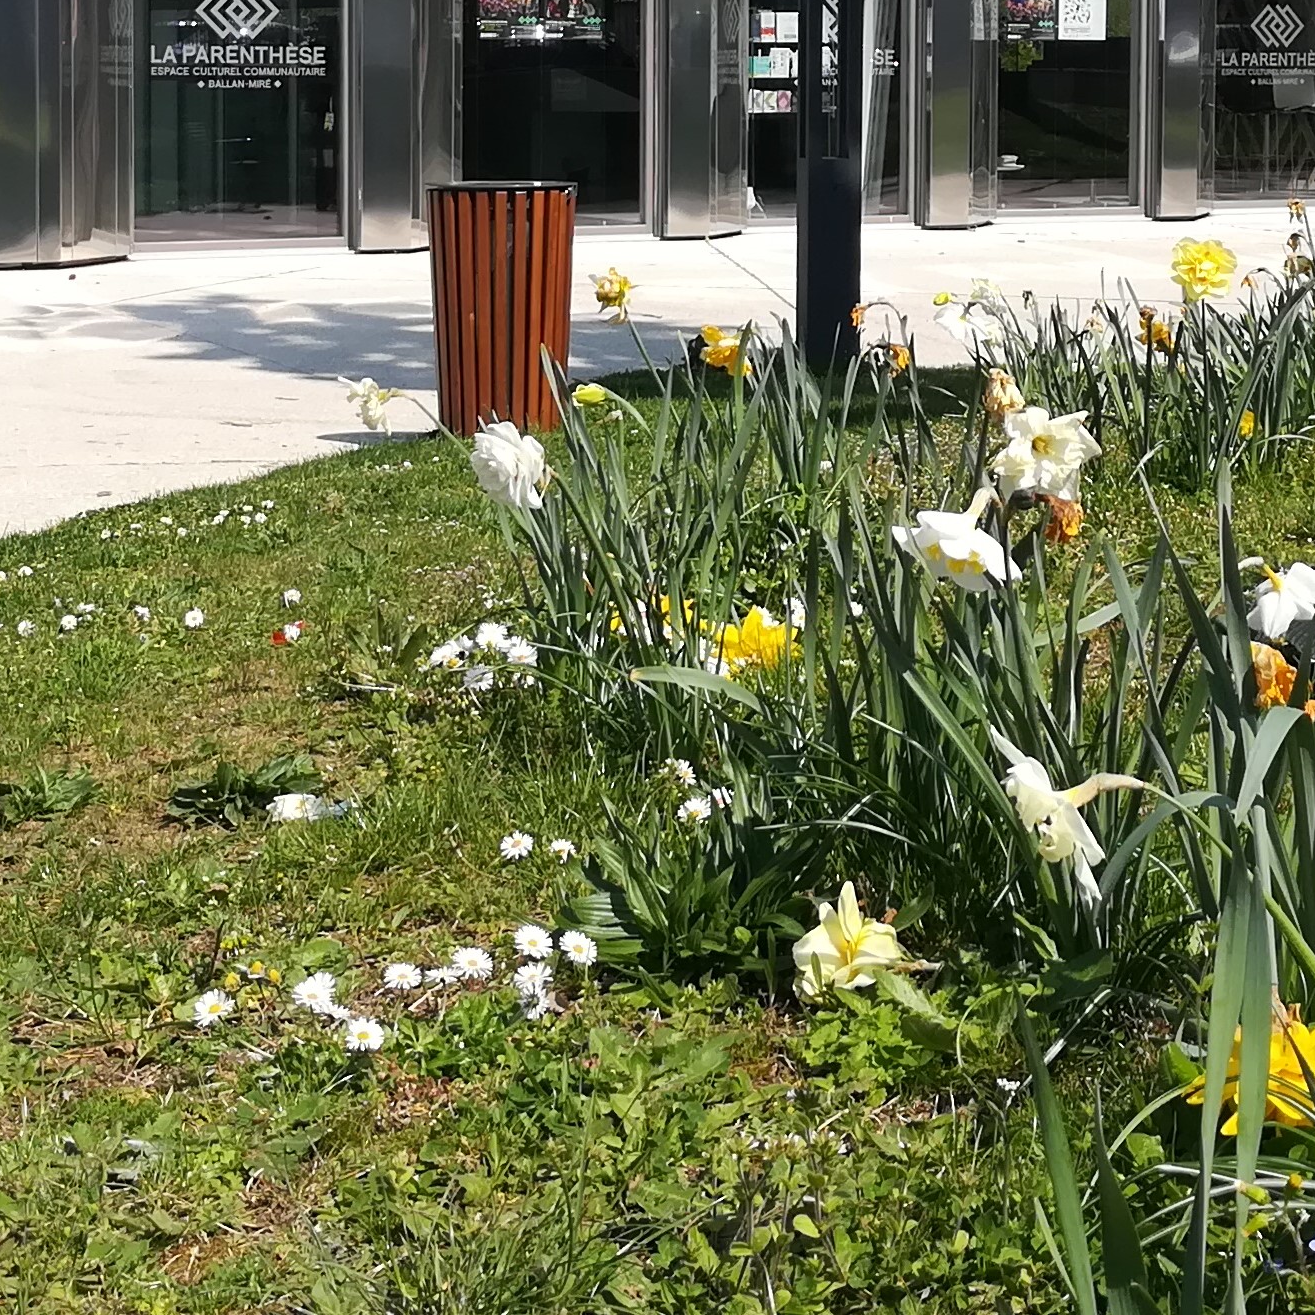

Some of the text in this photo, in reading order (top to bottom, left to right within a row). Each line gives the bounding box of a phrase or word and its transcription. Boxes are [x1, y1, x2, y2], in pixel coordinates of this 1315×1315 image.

[150, 45, 177, 64] LA
[182, 42, 327, 64] PARENTHÈSE
[1221, 52, 1238, 67] LA
[150, 66, 327, 77] ESPACE CULTUREL COMMUNAUTAIRE
[208, 78, 272, 89] BALLAN-MIRÉ
